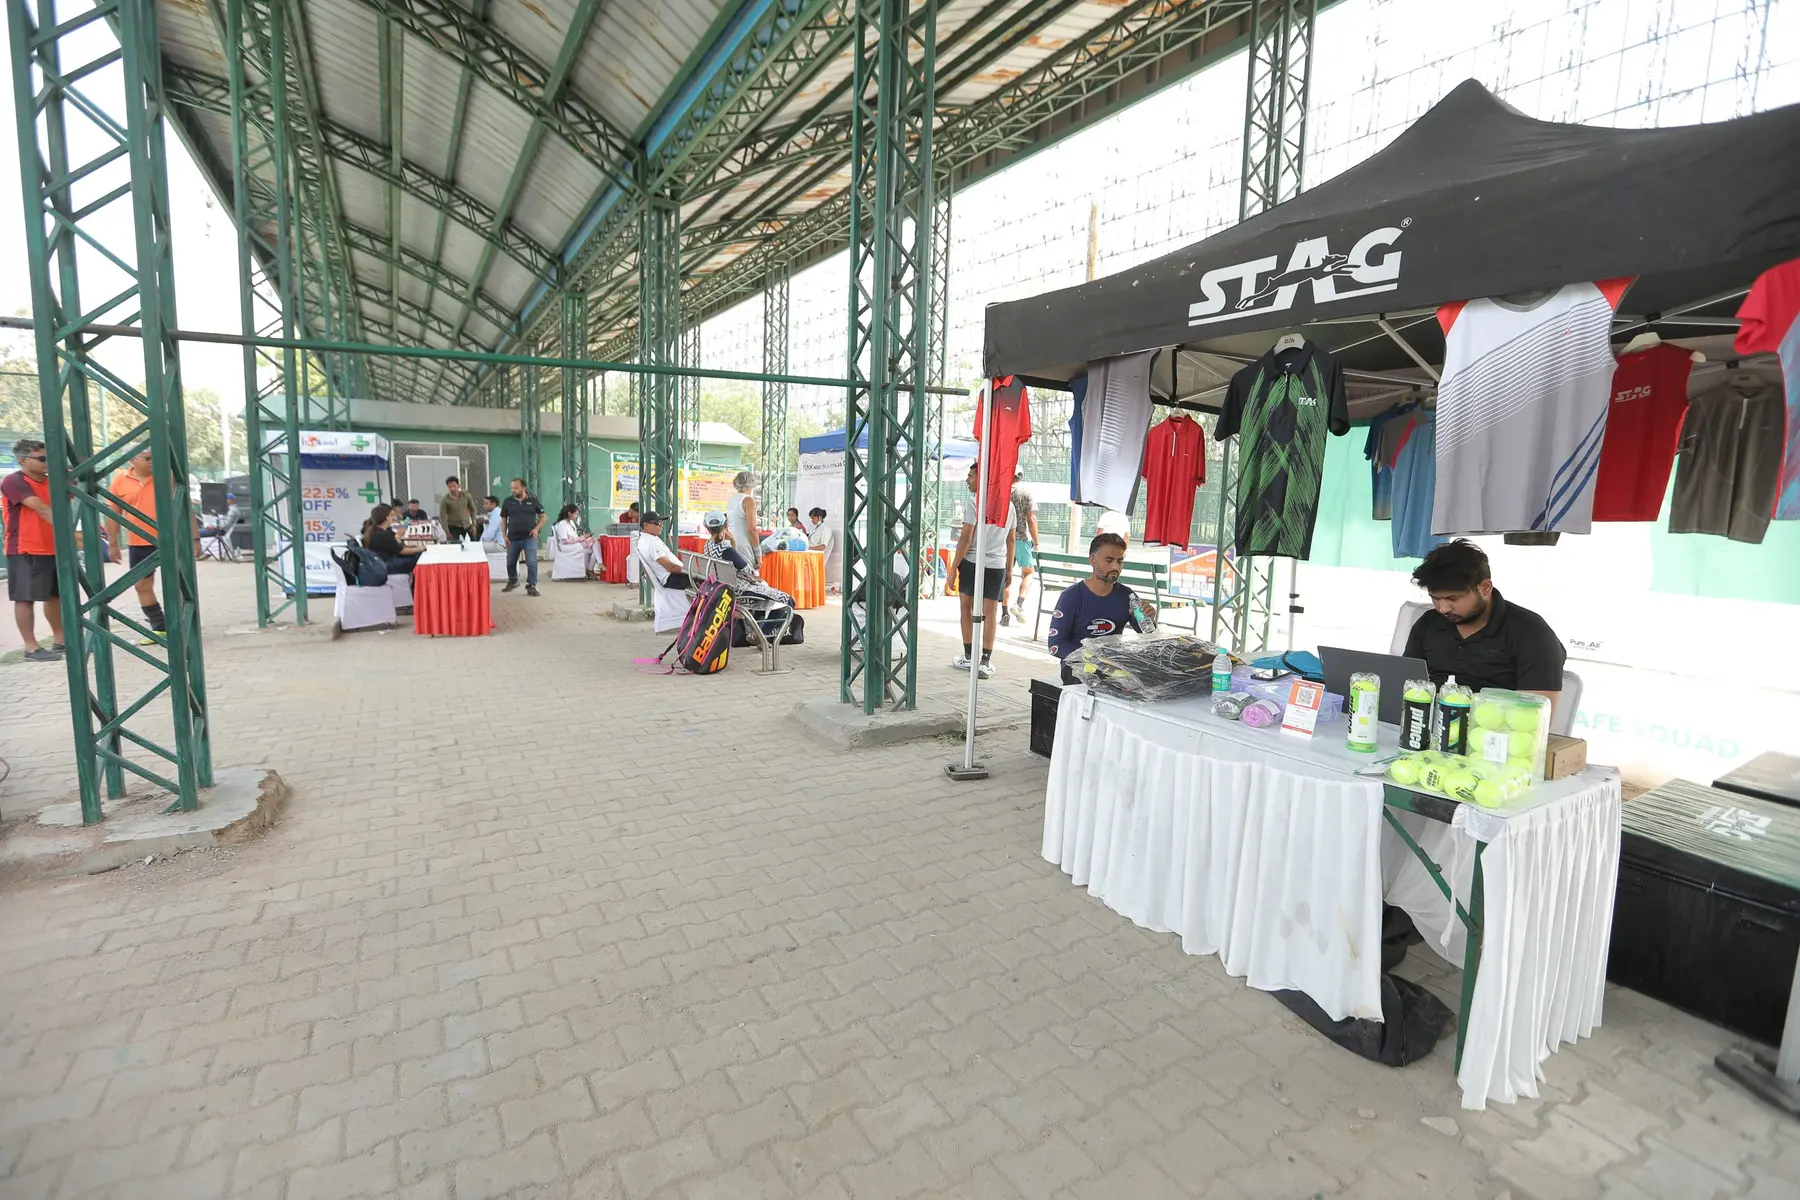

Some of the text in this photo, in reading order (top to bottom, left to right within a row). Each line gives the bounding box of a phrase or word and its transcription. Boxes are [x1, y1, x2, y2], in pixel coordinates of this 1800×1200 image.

[1188, 226, 1403, 326] STAG
[1615, 385, 1652, 403] STAG
[302, 487, 349, 499] 22.5%
[303, 500, 332, 511] OFF
[304, 520, 336, 532] 15%
[692, 588, 733, 665] Babolat
[1408, 706, 1426, 750] prince
[1574, 709, 1742, 758] AFE SQUAD
